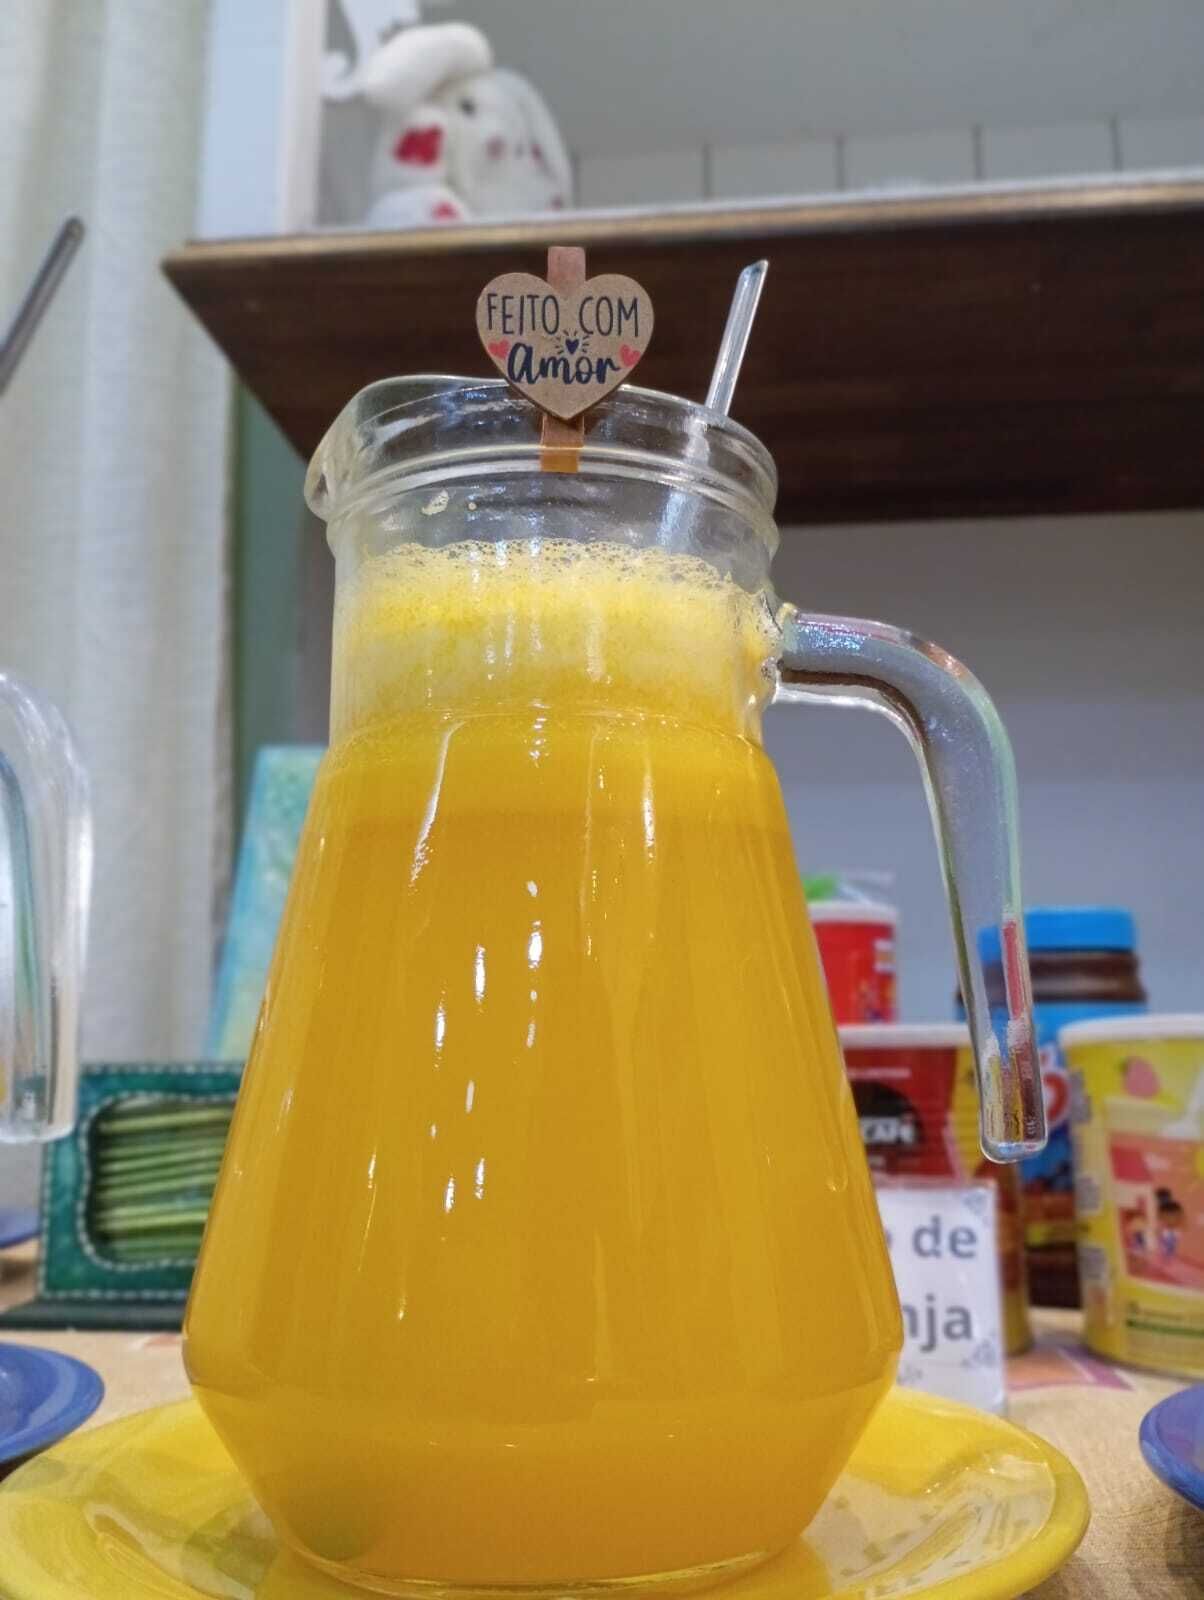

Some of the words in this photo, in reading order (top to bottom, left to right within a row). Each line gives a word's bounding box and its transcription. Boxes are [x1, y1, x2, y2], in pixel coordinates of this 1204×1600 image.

[486, 293, 560, 335] FEITO
[578, 296, 639, 337] COM
[912, 1214, 978, 1259] de
